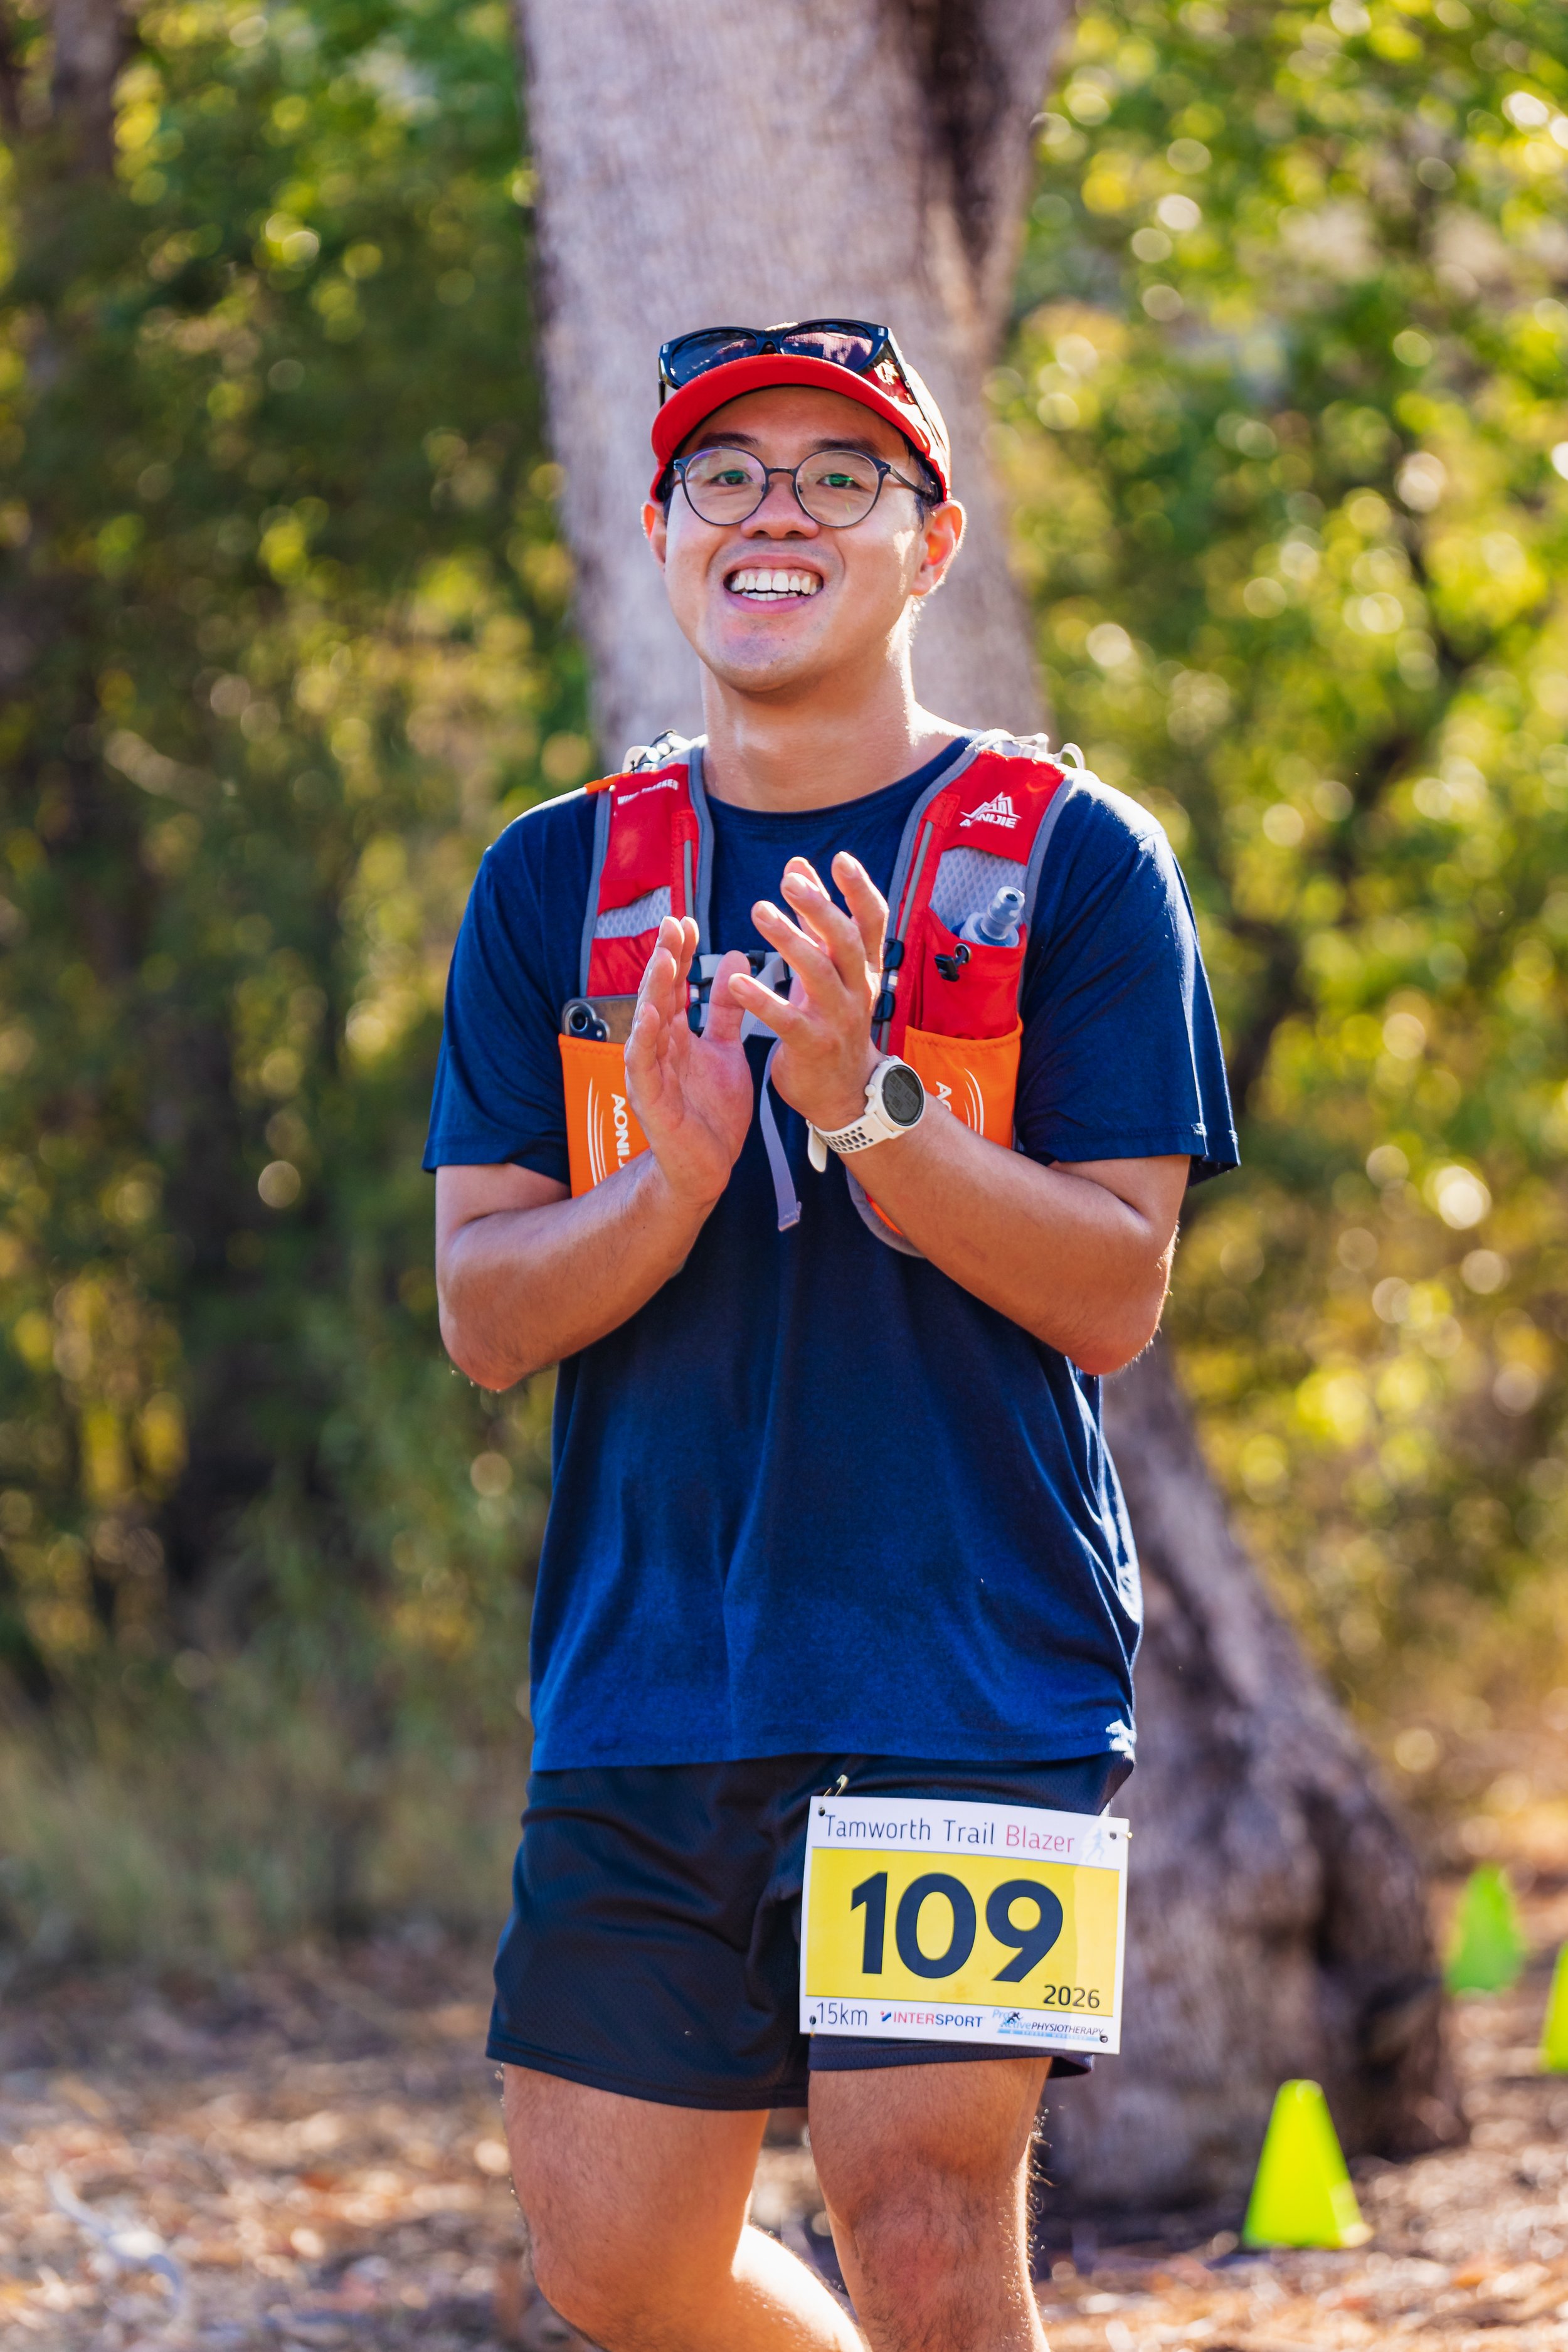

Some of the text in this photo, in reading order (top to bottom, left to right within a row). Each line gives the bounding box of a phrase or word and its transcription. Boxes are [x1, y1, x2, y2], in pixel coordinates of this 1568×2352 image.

[825, 1814, 1075, 1853] Tamworth Trail Blazer
[850, 1871, 1063, 1983] 109
[1043, 1984, 1100, 2009] 2026
[817, 2002, 867, 2026] 15km
[894, 2011, 983, 2028] INTERSPORT
